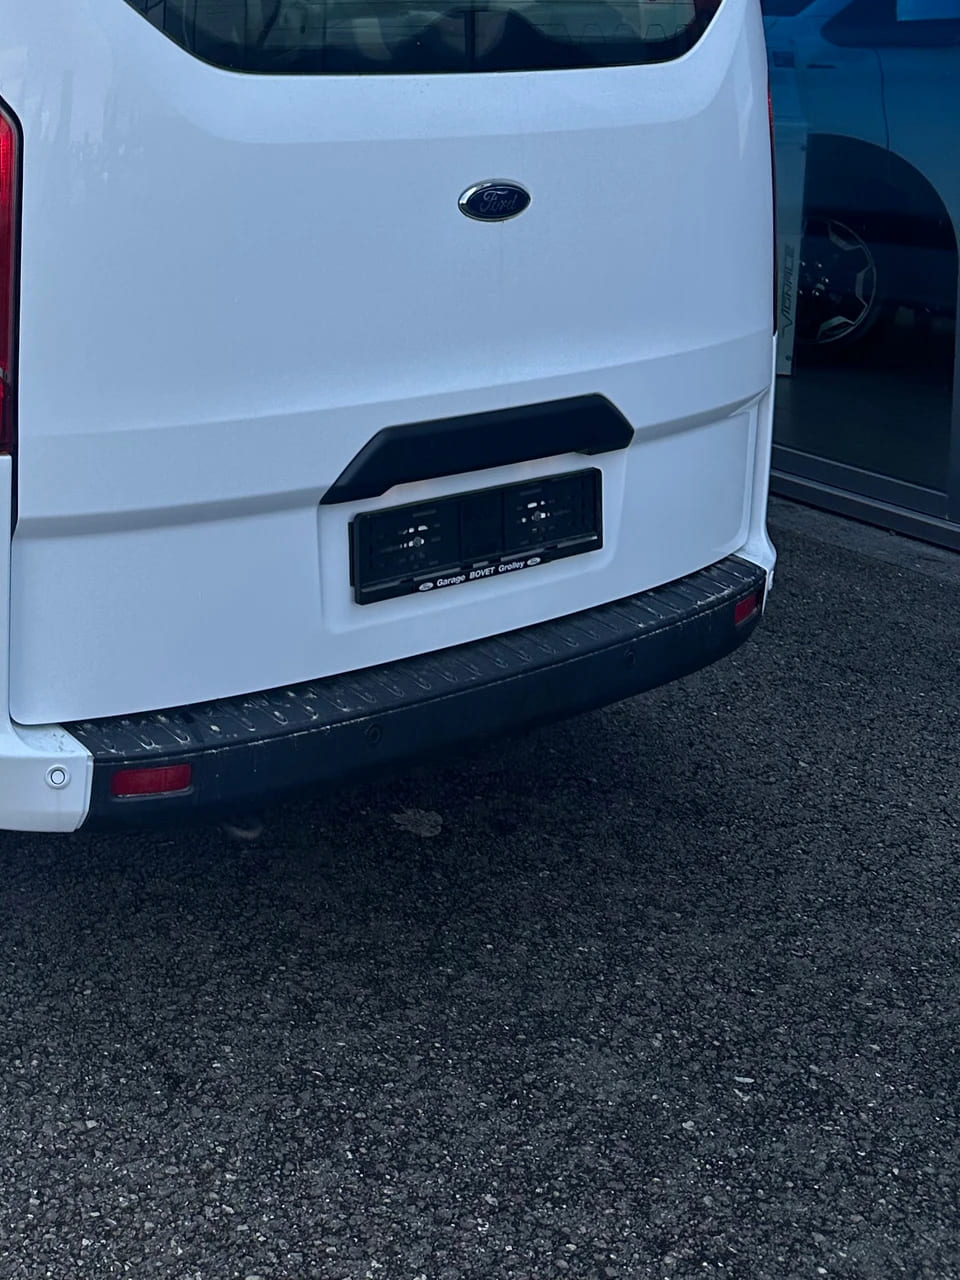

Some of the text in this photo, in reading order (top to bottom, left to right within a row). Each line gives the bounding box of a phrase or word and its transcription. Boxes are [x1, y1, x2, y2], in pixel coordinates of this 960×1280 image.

[480, 190, 518, 212] Ford
[437, 574, 466, 587] Garage
[469, 567, 495, 579] BOVET
[498, 561, 525, 573] Grolley
